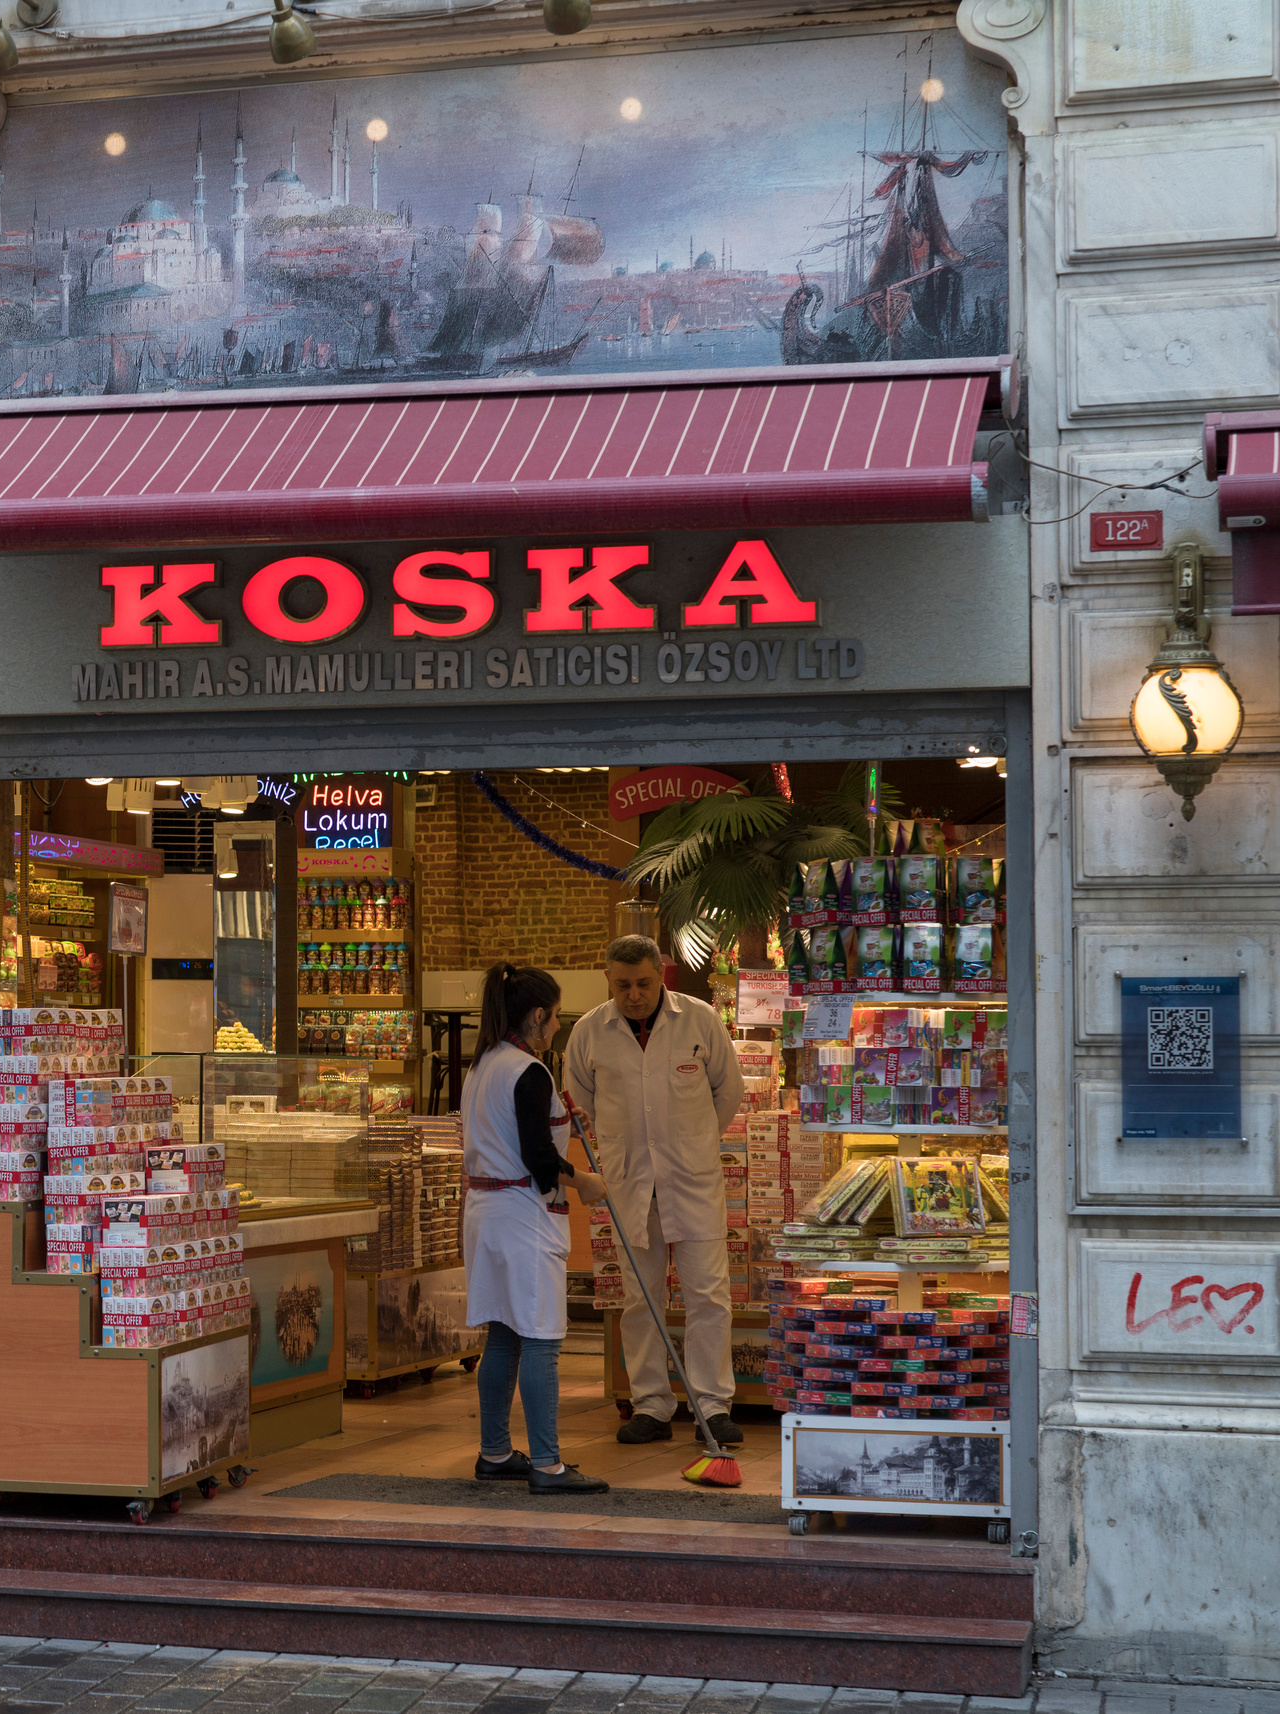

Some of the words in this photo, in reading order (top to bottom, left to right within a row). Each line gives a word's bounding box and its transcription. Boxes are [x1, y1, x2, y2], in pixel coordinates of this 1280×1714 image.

[99, 538, 818, 649] KOSKA
[72, 660, 181, 701] MAHIR
[486, 644, 641, 689] SATICISI
[657, 631, 783, 684] ÖZSOY
[797, 637, 864, 679] LTD
[313, 785, 382, 806] Helva
[615, 778, 685, 809] SPECIAL
[304, 810, 387, 832] Lokum
[922, 910, 937, 920] OFFE
[745, 972, 781, 980] SPECIAL
[878, 978, 894, 988] OFFE
[766, 1009, 781, 1020] 78
[12, 1026, 25, 1036] OFFER
[16, 1074, 32, 1084] OFFER
[66, 1087, 75, 1104] OFFER
[67, 1108, 75, 1126] SPECIAL
[1, 1124, 15, 1133] OFFER
[50, 1148, 71, 1158] SPECIAL
[72, 1146, 89, 1156] OFFER
[46, 1195, 64, 1205] SPECIAL
[64, 1196, 79, 1205] OFFER
[47, 1242, 68, 1251] SPECIAL
[69, 1243, 85, 1252] OFFER
[102, 1268, 122, 1278] SPECIAL
[122, 1268, 139, 1278] OFFER
[104, 1315, 124, 1325] SPECIAL
[126, 1315, 142, 1325] OFFER
